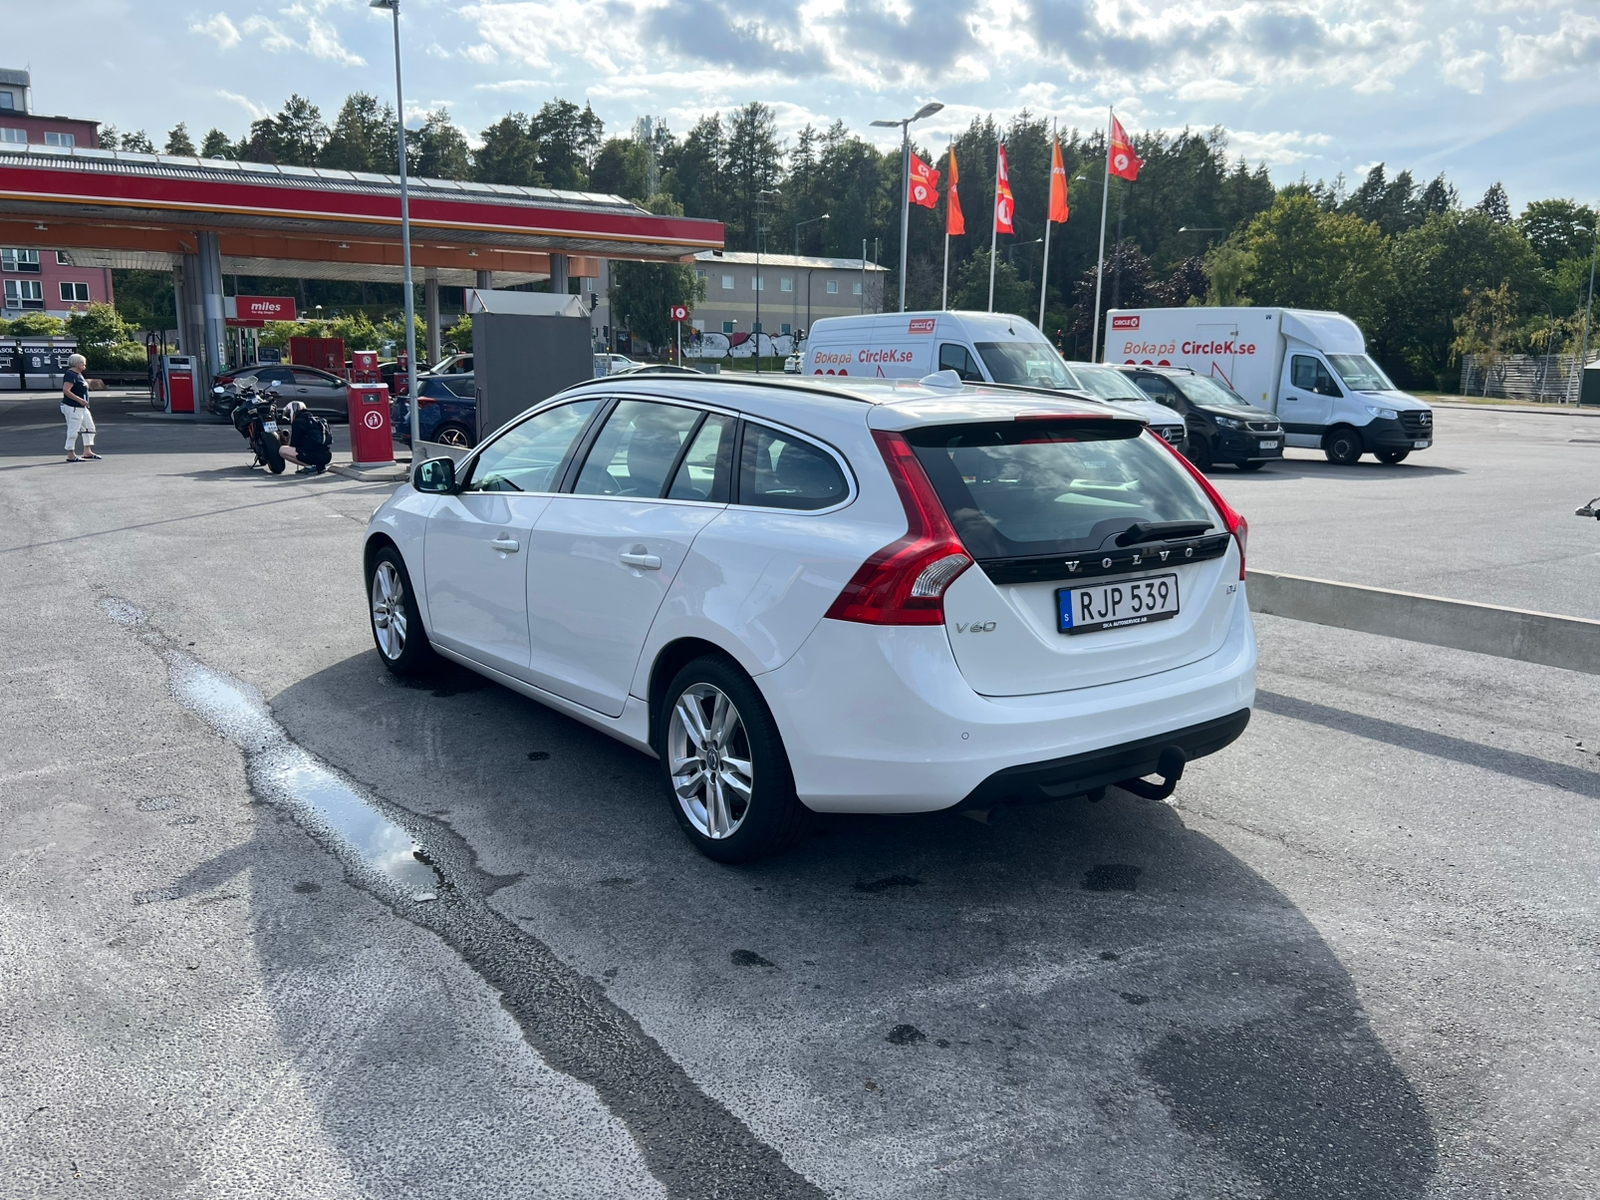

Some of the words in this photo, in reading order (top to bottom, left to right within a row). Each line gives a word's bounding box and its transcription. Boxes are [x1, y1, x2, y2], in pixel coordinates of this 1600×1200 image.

[251, 302, 281, 311] miles
[1123, 341, 1156, 355] Boka
[1157, 339, 1176, 356] på
[1181, 341, 1256, 355] CircleK.se
[814, 351, 839, 364] Boka
[838, 349, 852, 365] på
[858, 349, 913, 363] CircleK.se
[1065, 547, 1194, 572] VOLVO
[1080, 587, 1123, 621] RJP
[1131, 581, 1169, 613] 539
[955, 620, 997, 634] V60
[1113, 618, 1140, 627] AUTOSERVICE
